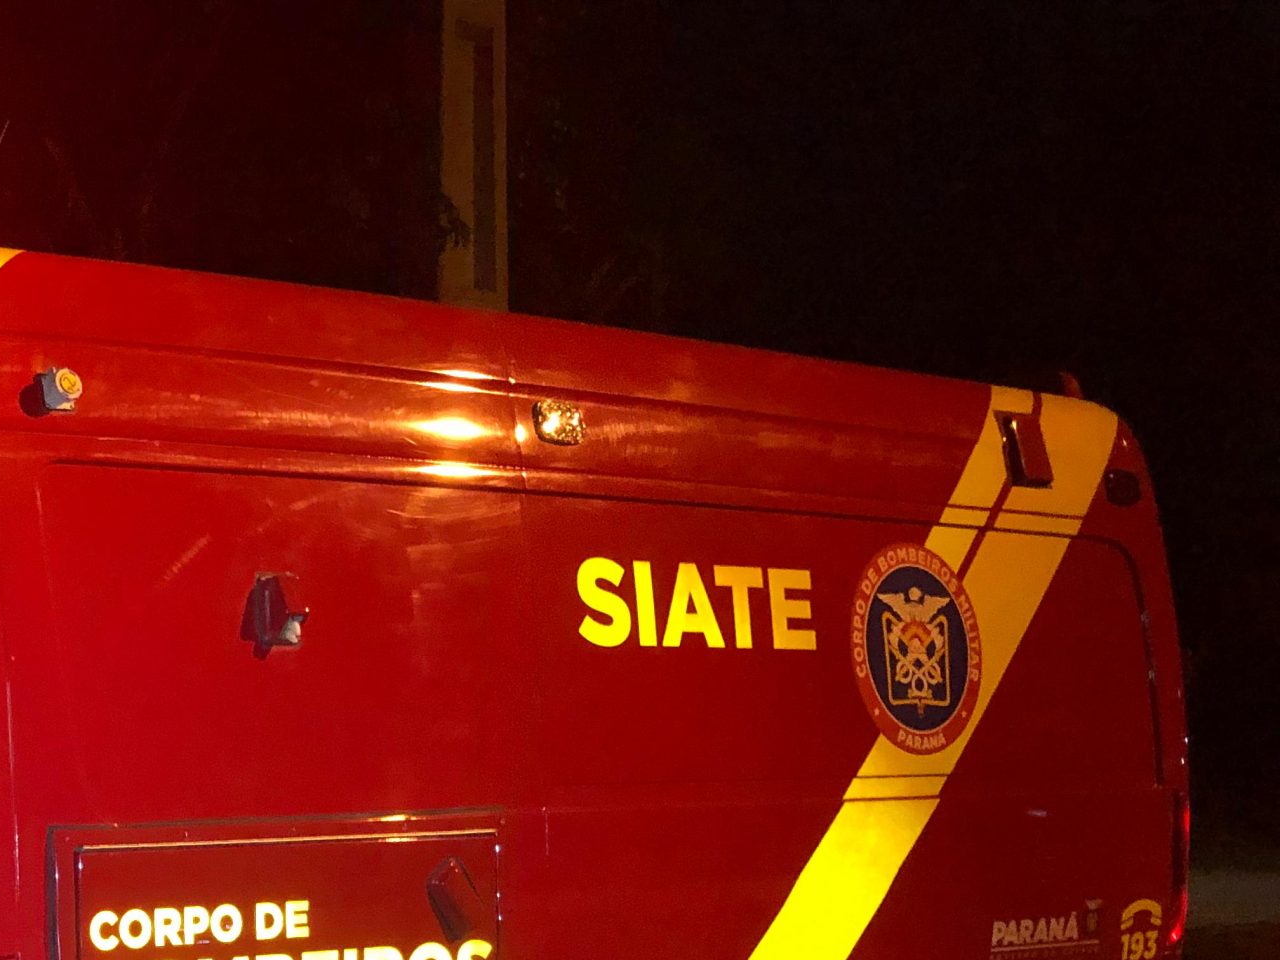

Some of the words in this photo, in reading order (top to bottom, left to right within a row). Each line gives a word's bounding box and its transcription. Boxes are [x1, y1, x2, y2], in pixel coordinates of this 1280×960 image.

[577, 557, 817, 650] SIATE
[853, 599, 868, 678] CORPO
[862, 568, 878, 595] DE
[878, 548, 958, 591] BOMBEIROS
[959, 595, 981, 682] MILITAR
[89, 903, 243, 951] CORPO
[255, 900, 310, 940] DE
[991, 911, 1079, 946] PARANÁ
[1121, 930, 1158, 960] 193
